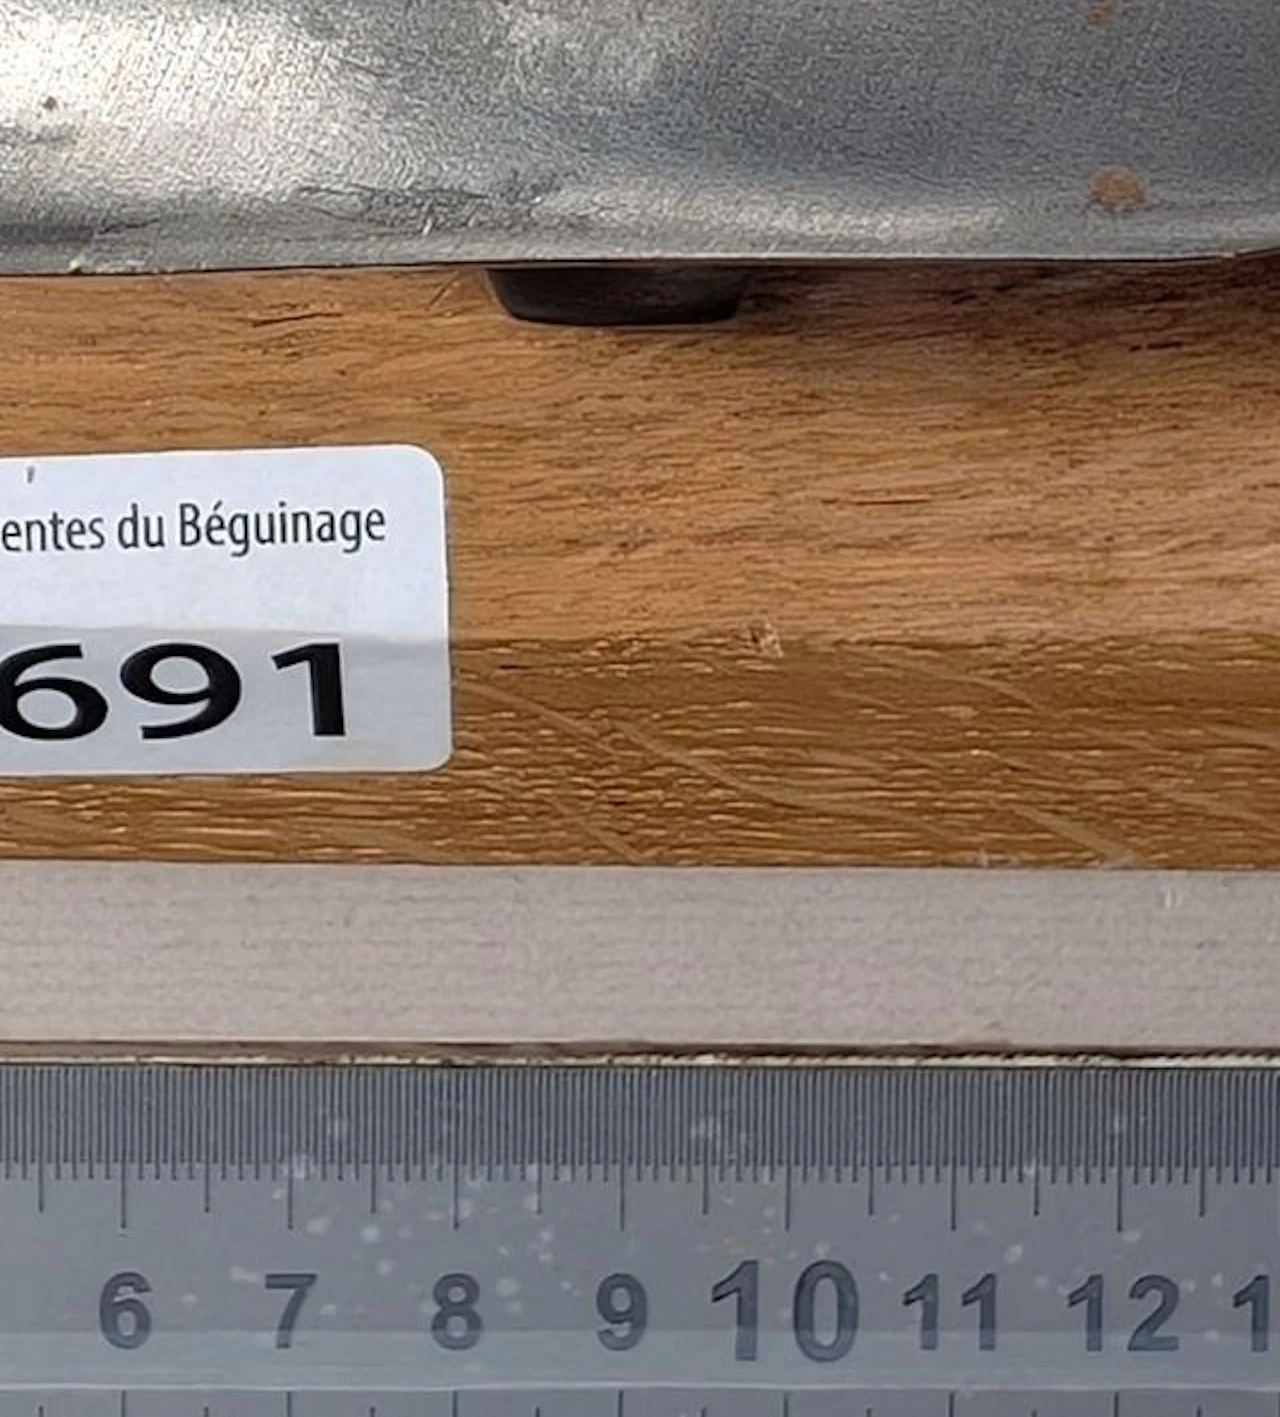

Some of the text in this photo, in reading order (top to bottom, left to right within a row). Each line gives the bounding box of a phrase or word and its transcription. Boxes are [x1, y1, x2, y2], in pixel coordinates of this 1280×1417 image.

[117, 504, 165, 550] du
[181, 499, 387, 555] Béguinage
[98, 1272, 152, 1349] 6
[265, 1272, 318, 1349] 7
[431, 1273, 483, 1351] 8
[595, 1273, 648, 1352] 9
[711, 1259, 859, 1363] 10
[903, 1273, 998, 1352] 11
[1067, 1274, 1180, 1352] 12
